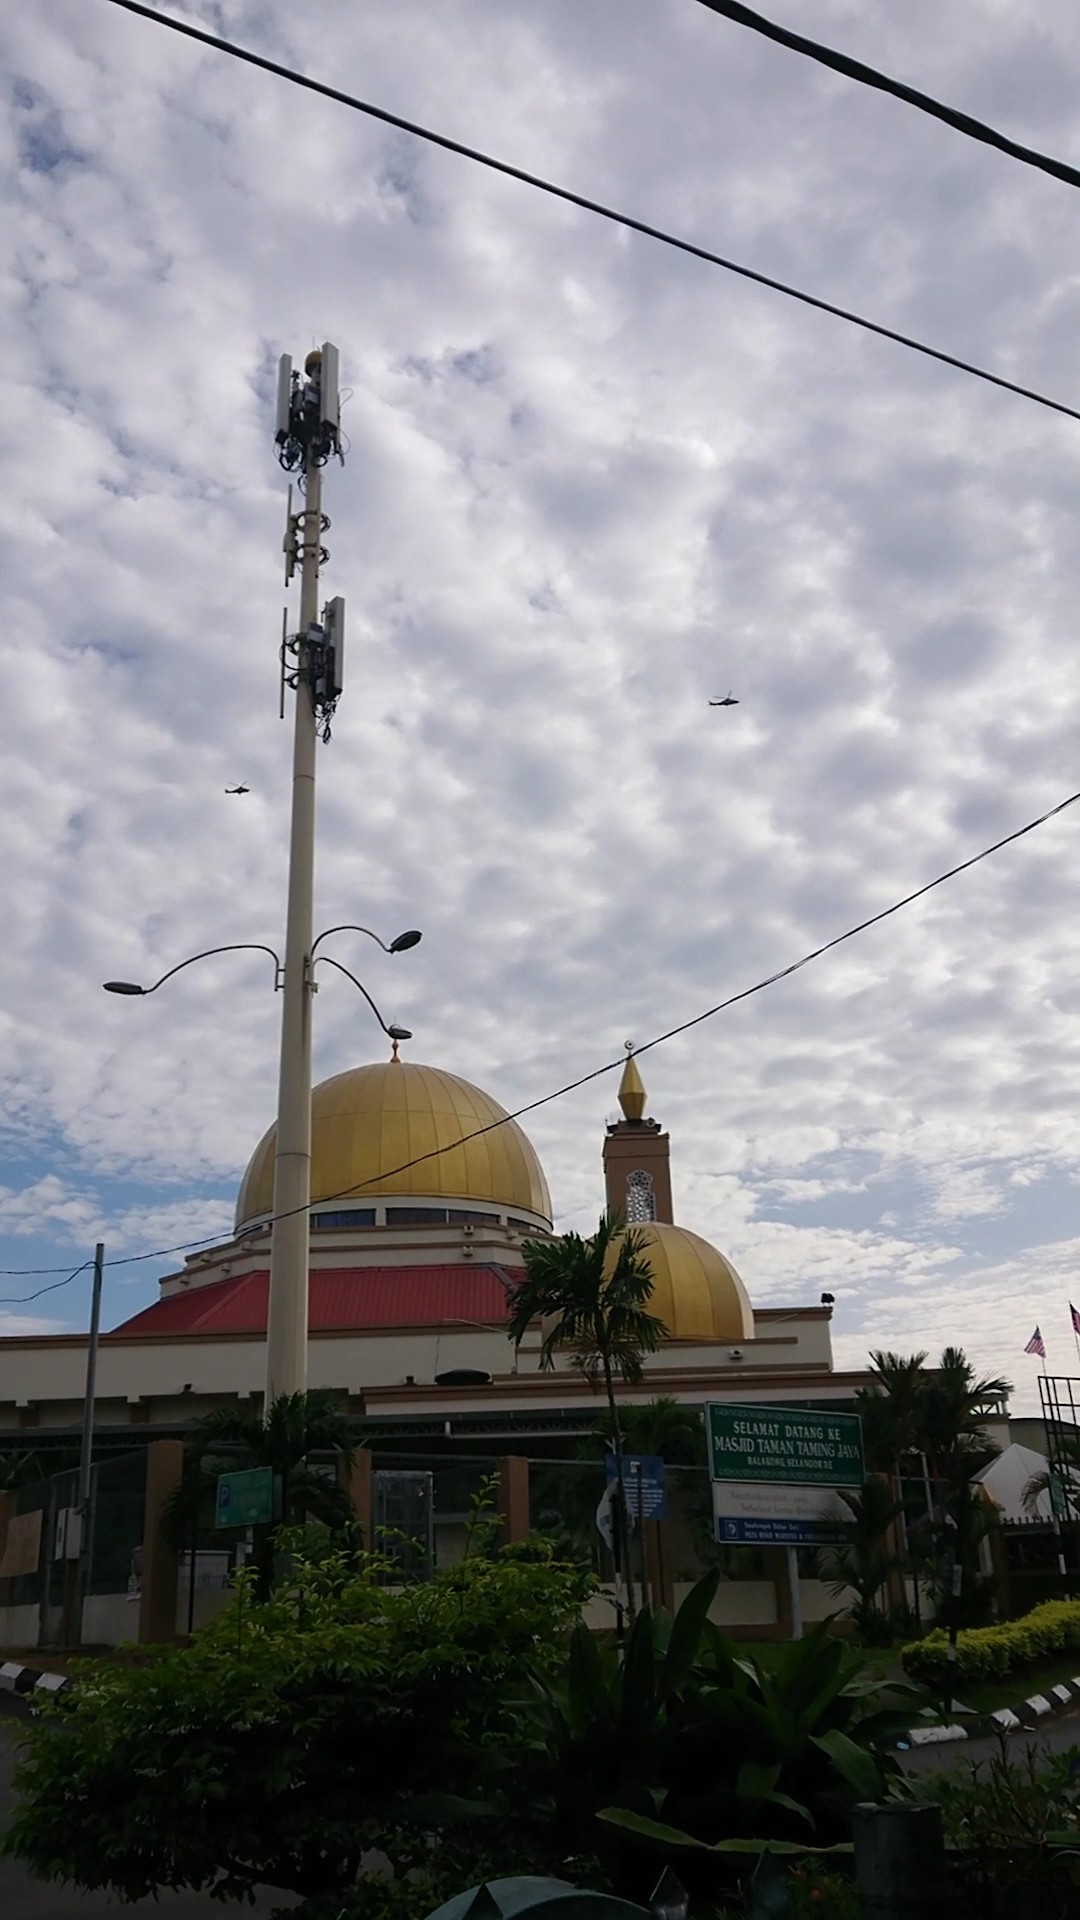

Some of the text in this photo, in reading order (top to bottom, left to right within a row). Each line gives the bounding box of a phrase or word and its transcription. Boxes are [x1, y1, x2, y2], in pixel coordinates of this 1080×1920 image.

[733, 1421, 841, 1440] SELAMAT DATANG KE
[714, 1436, 860, 1459] MASJID TAMAN TAMING JAYA
[747, 1456, 785, 1467] BALAKONG
[787, 1458, 822, 1469] SELANGOR
